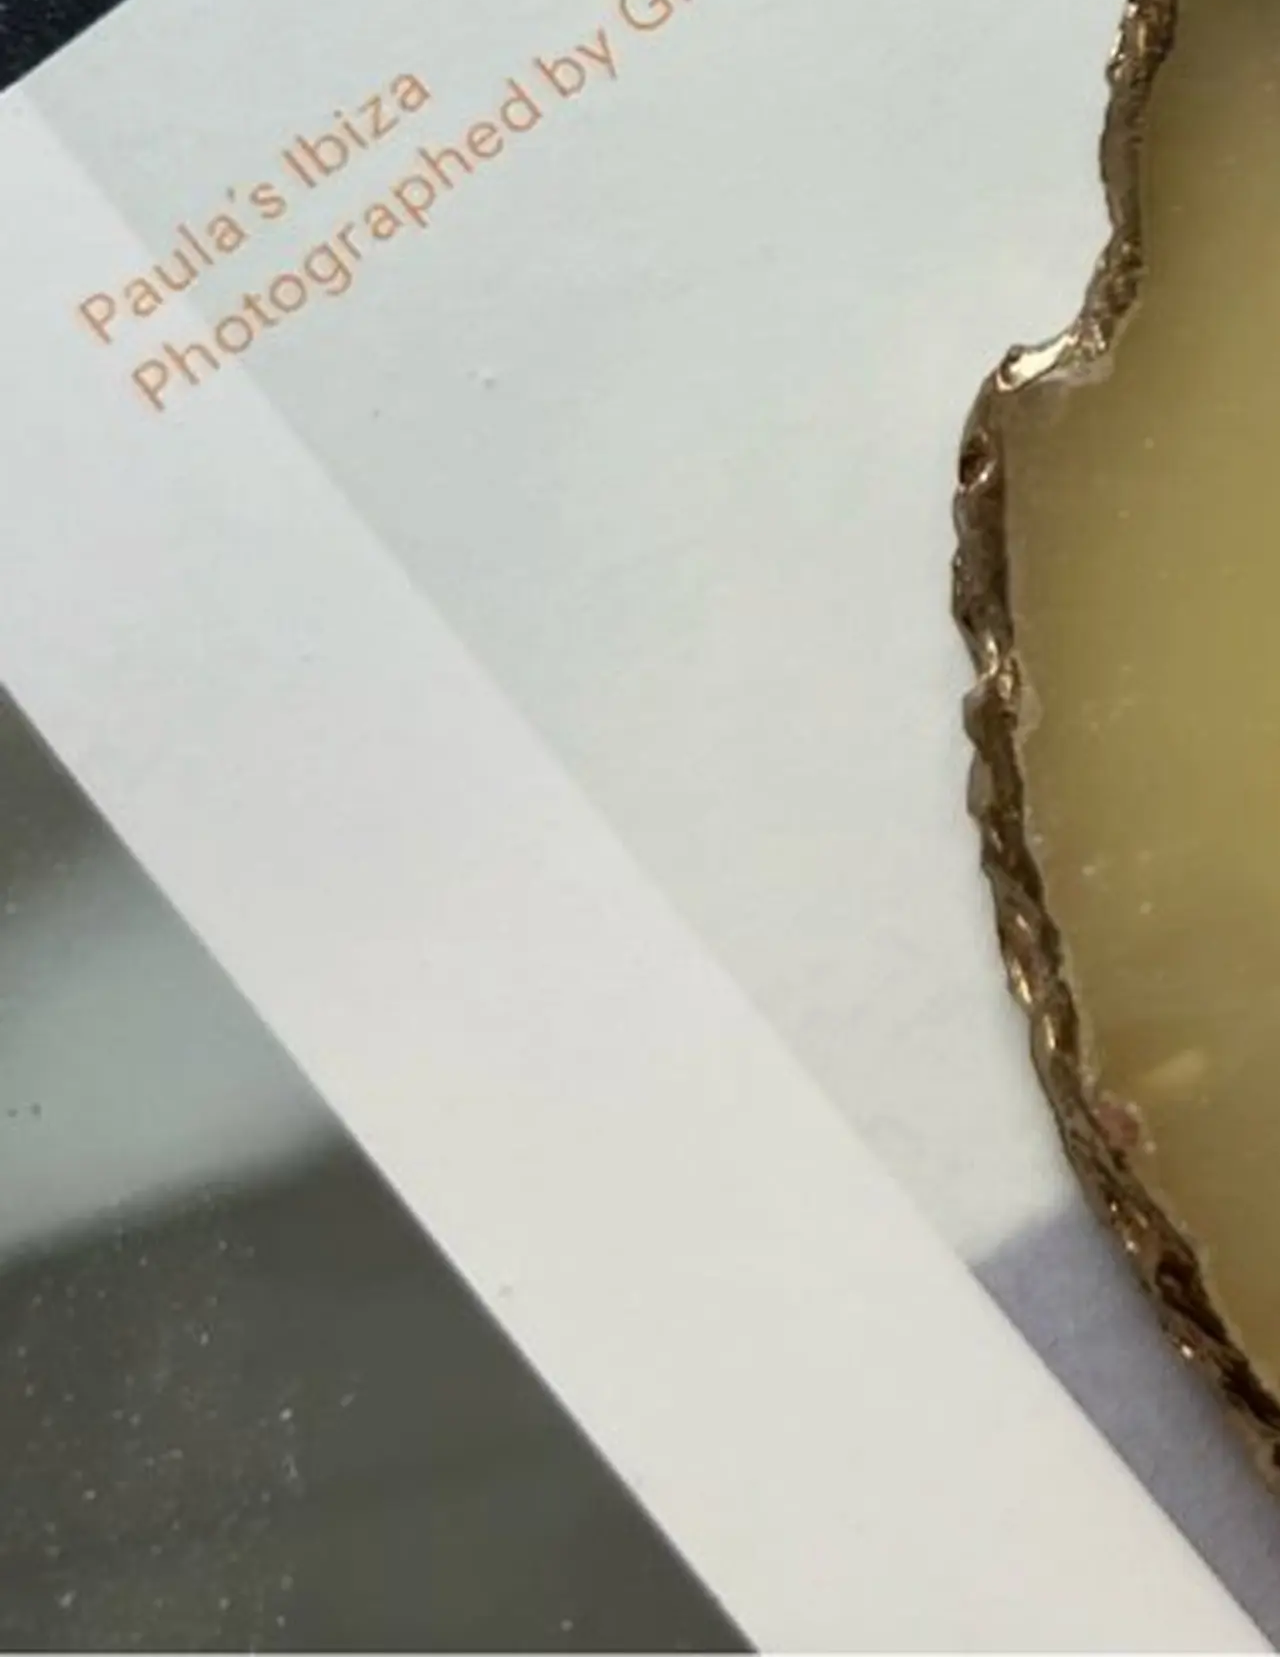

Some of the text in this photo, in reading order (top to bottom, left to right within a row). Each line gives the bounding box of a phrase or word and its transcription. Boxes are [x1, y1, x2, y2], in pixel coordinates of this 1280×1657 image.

[75, 73, 432, 346] Paula's Ibiza
[130, 75, 543, 413] Photographed
[532, 28, 618, 99] by
